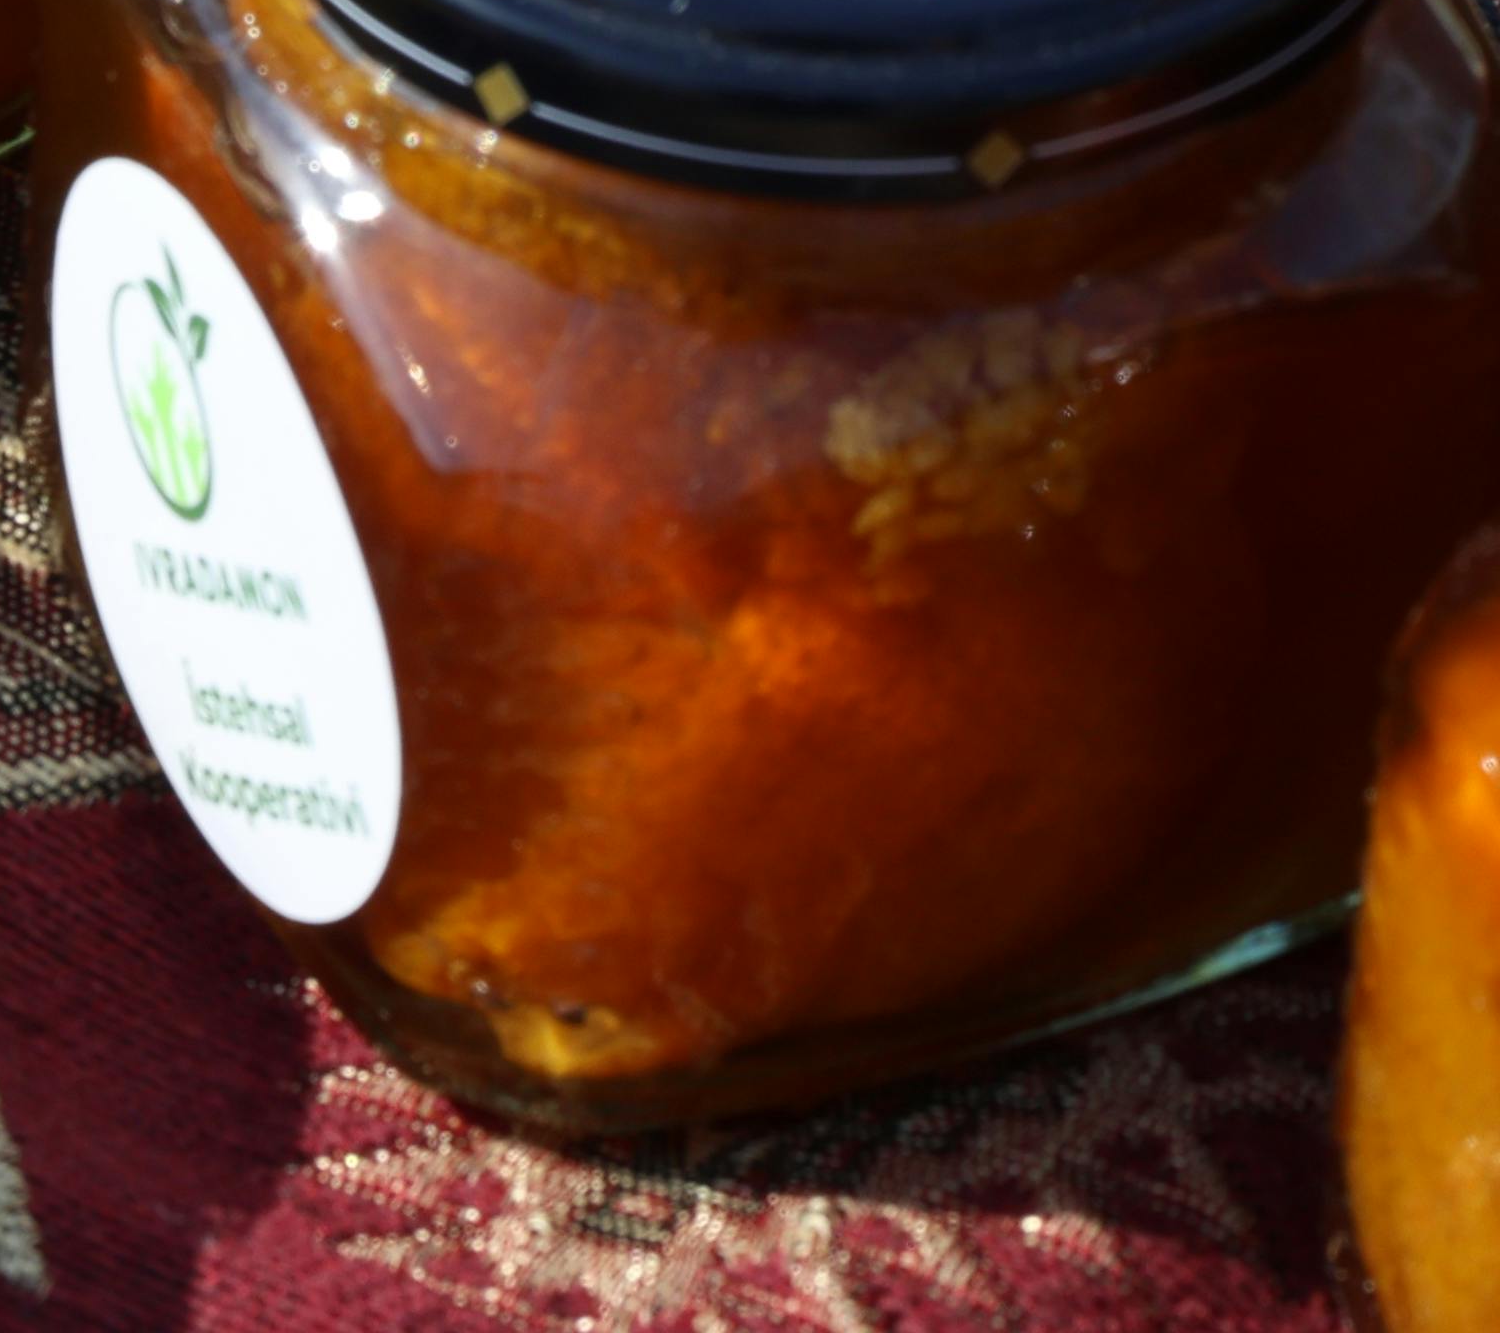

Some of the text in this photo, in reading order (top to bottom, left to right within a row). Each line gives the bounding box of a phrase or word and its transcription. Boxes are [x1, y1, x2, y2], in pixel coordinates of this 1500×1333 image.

[133, 540, 310, 622] IVRADAMON
[181, 656, 314, 748] İstehsal
[176, 743, 371, 841] Kooperativi
